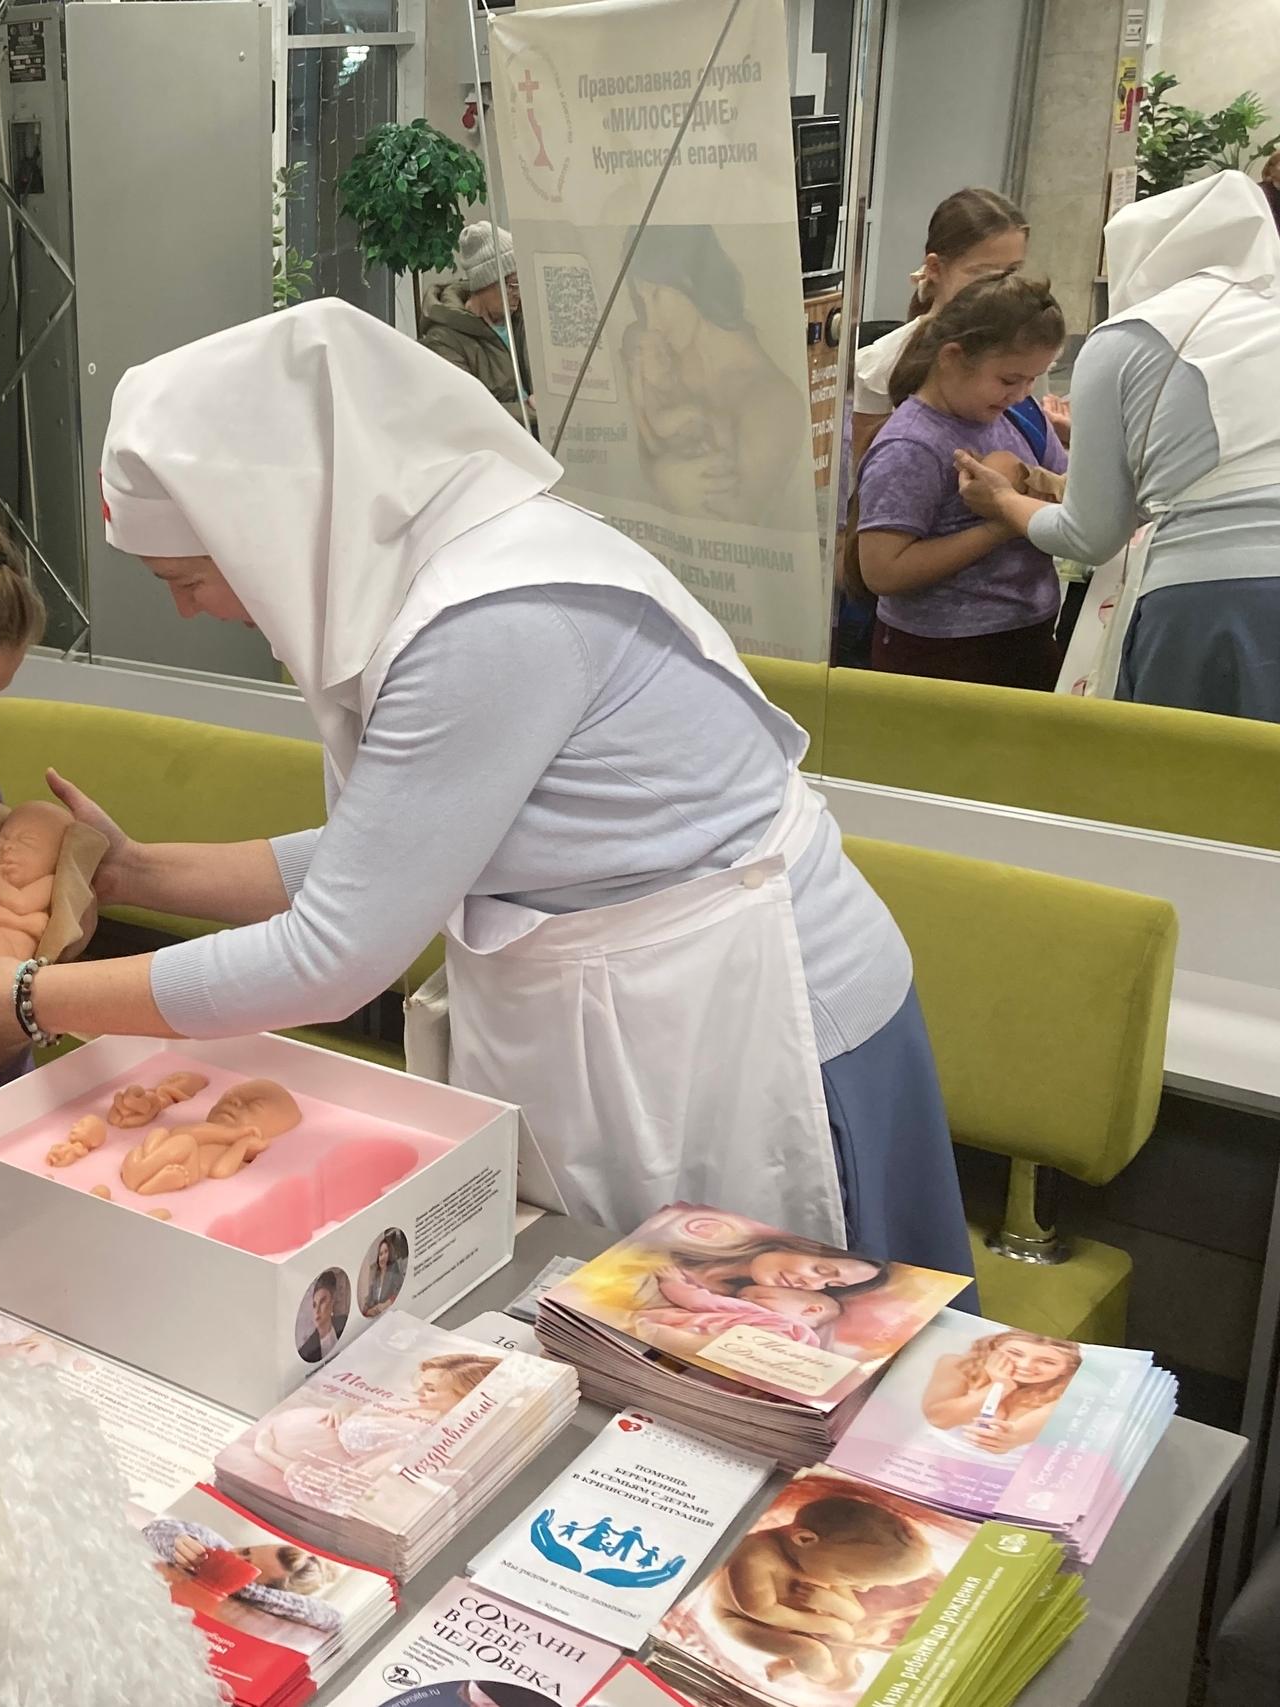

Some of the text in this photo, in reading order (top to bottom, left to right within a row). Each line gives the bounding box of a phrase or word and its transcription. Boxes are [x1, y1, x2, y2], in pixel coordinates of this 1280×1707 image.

[578, 69, 692, 103] Православная
[592, 142, 758, 175] Курганская епархия
[492, 1335, 519, 1350] 16
[332, 1372, 394, 1399] Мама
[398, 1391, 499, 1485] Поздравляем!
[600, 1472, 649, 1494] СЕМЬЯМ
[614, 1467, 697, 1501] БЕРЕМЕННЫМ
[635, 1464, 688, 1488] ПОМОЩЬ
[939, 1576, 983, 1625] рождения
[443, 1607, 528, 1656] В СЕБЕ
[459, 1596, 589, 1663] СОХРАНИ
[931, 1623, 950, 1640] до
[432, 1621, 568, 1699] ЧЕЛОВЕКА
[900, 1639, 940, 1681] ребенка
